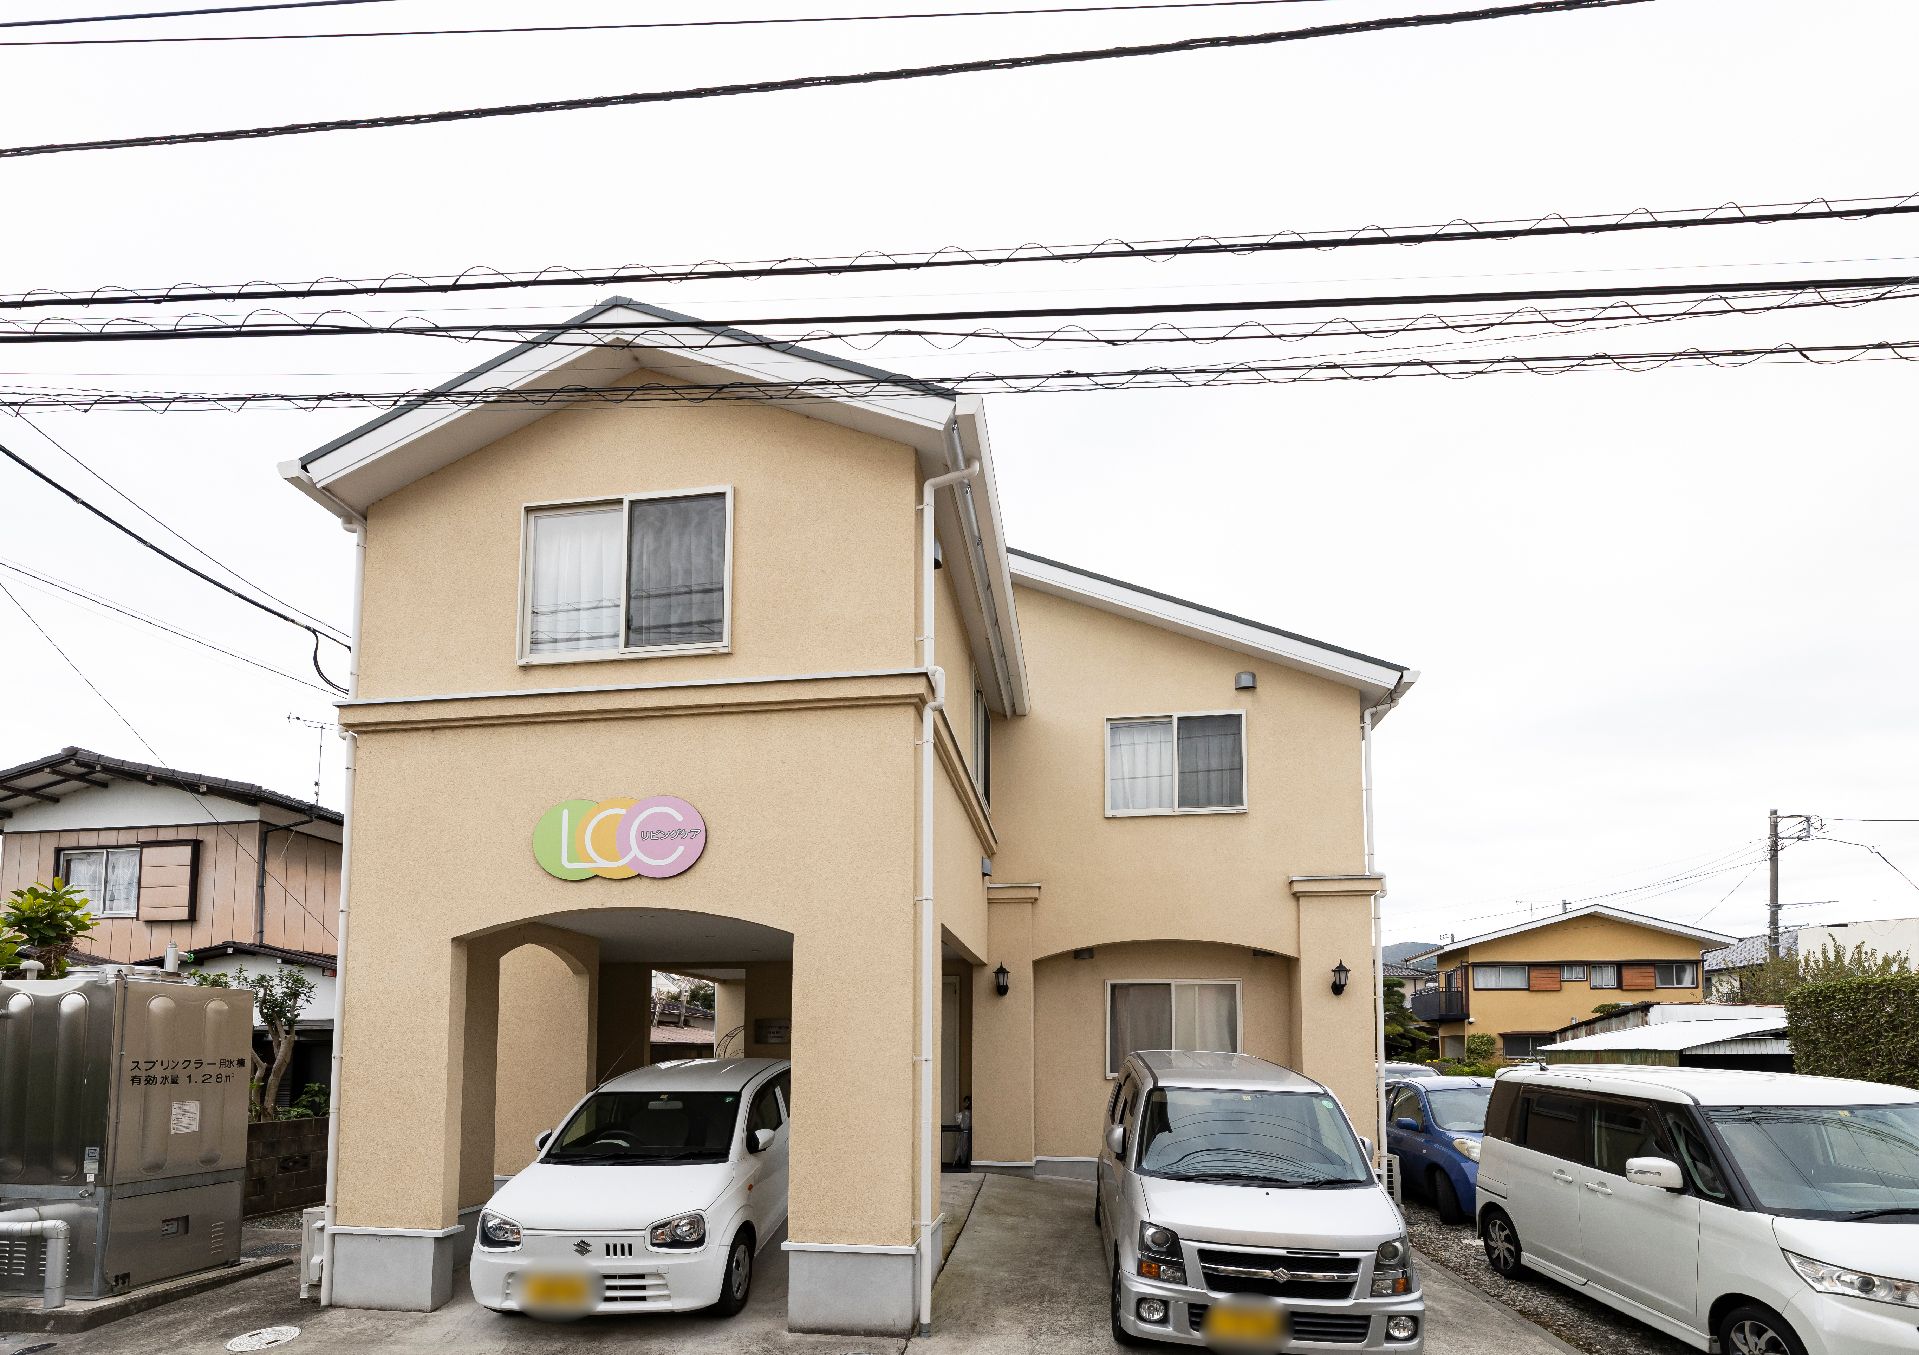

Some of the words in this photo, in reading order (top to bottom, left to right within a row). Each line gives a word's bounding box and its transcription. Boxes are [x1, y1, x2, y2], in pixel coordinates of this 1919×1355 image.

[561, 806, 685, 868] LCC
[130, 1074, 180, 1086] 有効水量
